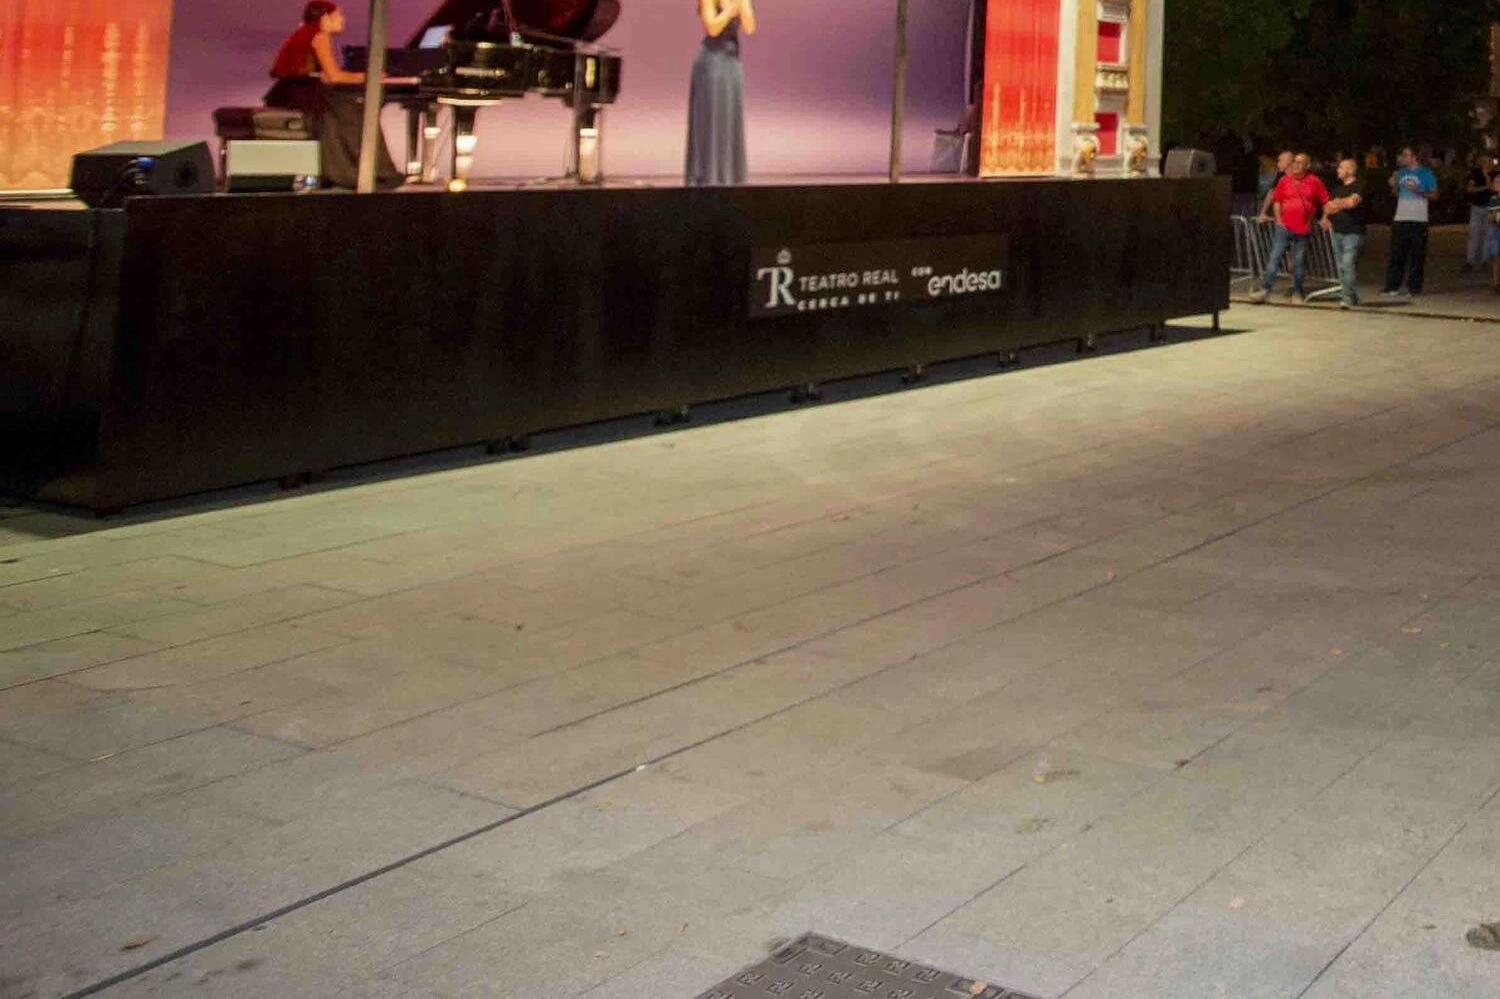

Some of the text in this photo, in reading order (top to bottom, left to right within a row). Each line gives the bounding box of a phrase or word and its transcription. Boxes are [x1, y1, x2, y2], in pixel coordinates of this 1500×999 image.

[799, 269, 899, 292] TEATRO REAL
[928, 267, 1002, 297] endesa
